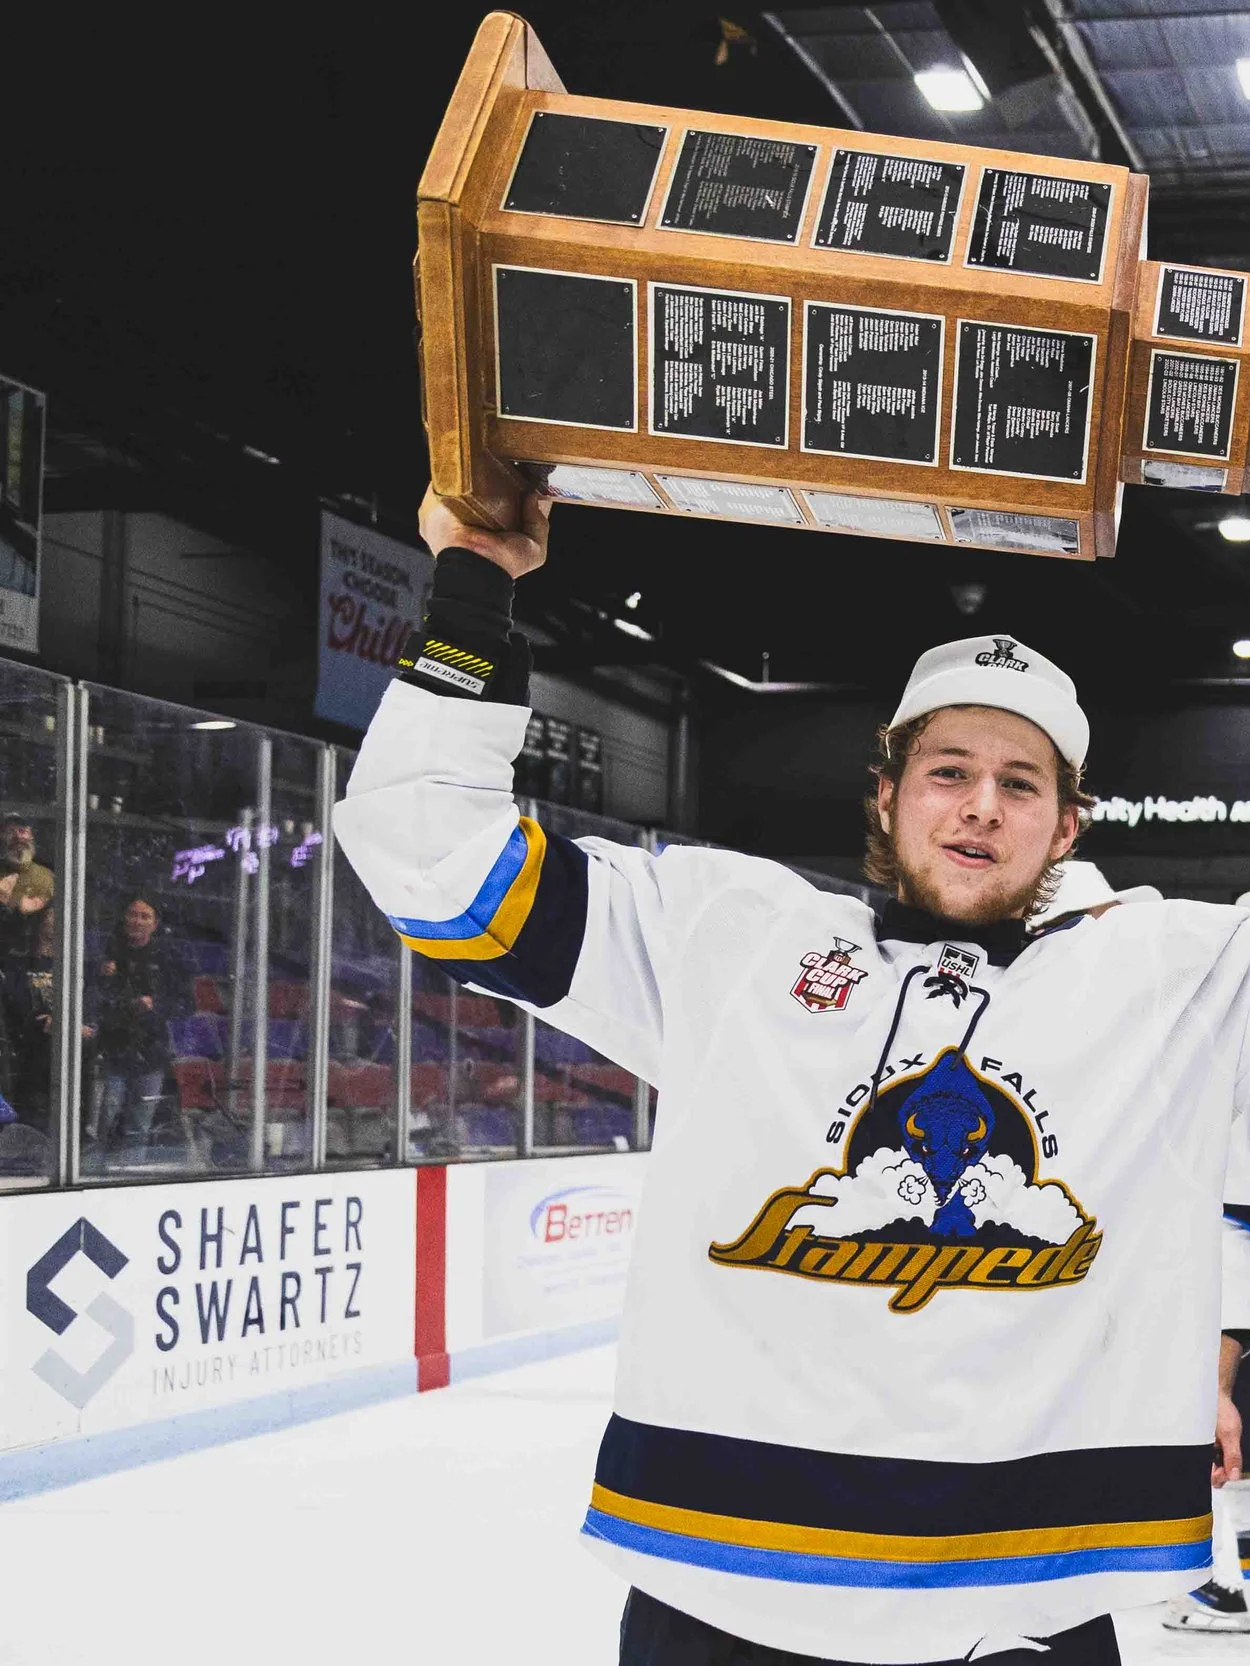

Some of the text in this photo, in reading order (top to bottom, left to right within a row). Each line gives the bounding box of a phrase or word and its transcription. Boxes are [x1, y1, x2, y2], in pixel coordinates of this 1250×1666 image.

[975, 652, 1029, 672] CLARK
[1144, 796, 1228, 822] Health
[801, 952, 868, 985] CLARK
[805, 968, 849, 988] CUP
[941, 958, 972, 977] USHL
[807, 983, 835, 999] FINAL
[981, 1056, 1058, 1159] FALLS
[156, 1196, 364, 1276] SHAFER
[708, 1187, 1103, 1314] Stampede
[155, 1263, 363, 1353] SWARTZ
[152, 1331, 364, 1396] INJURY ATTORNEYS
